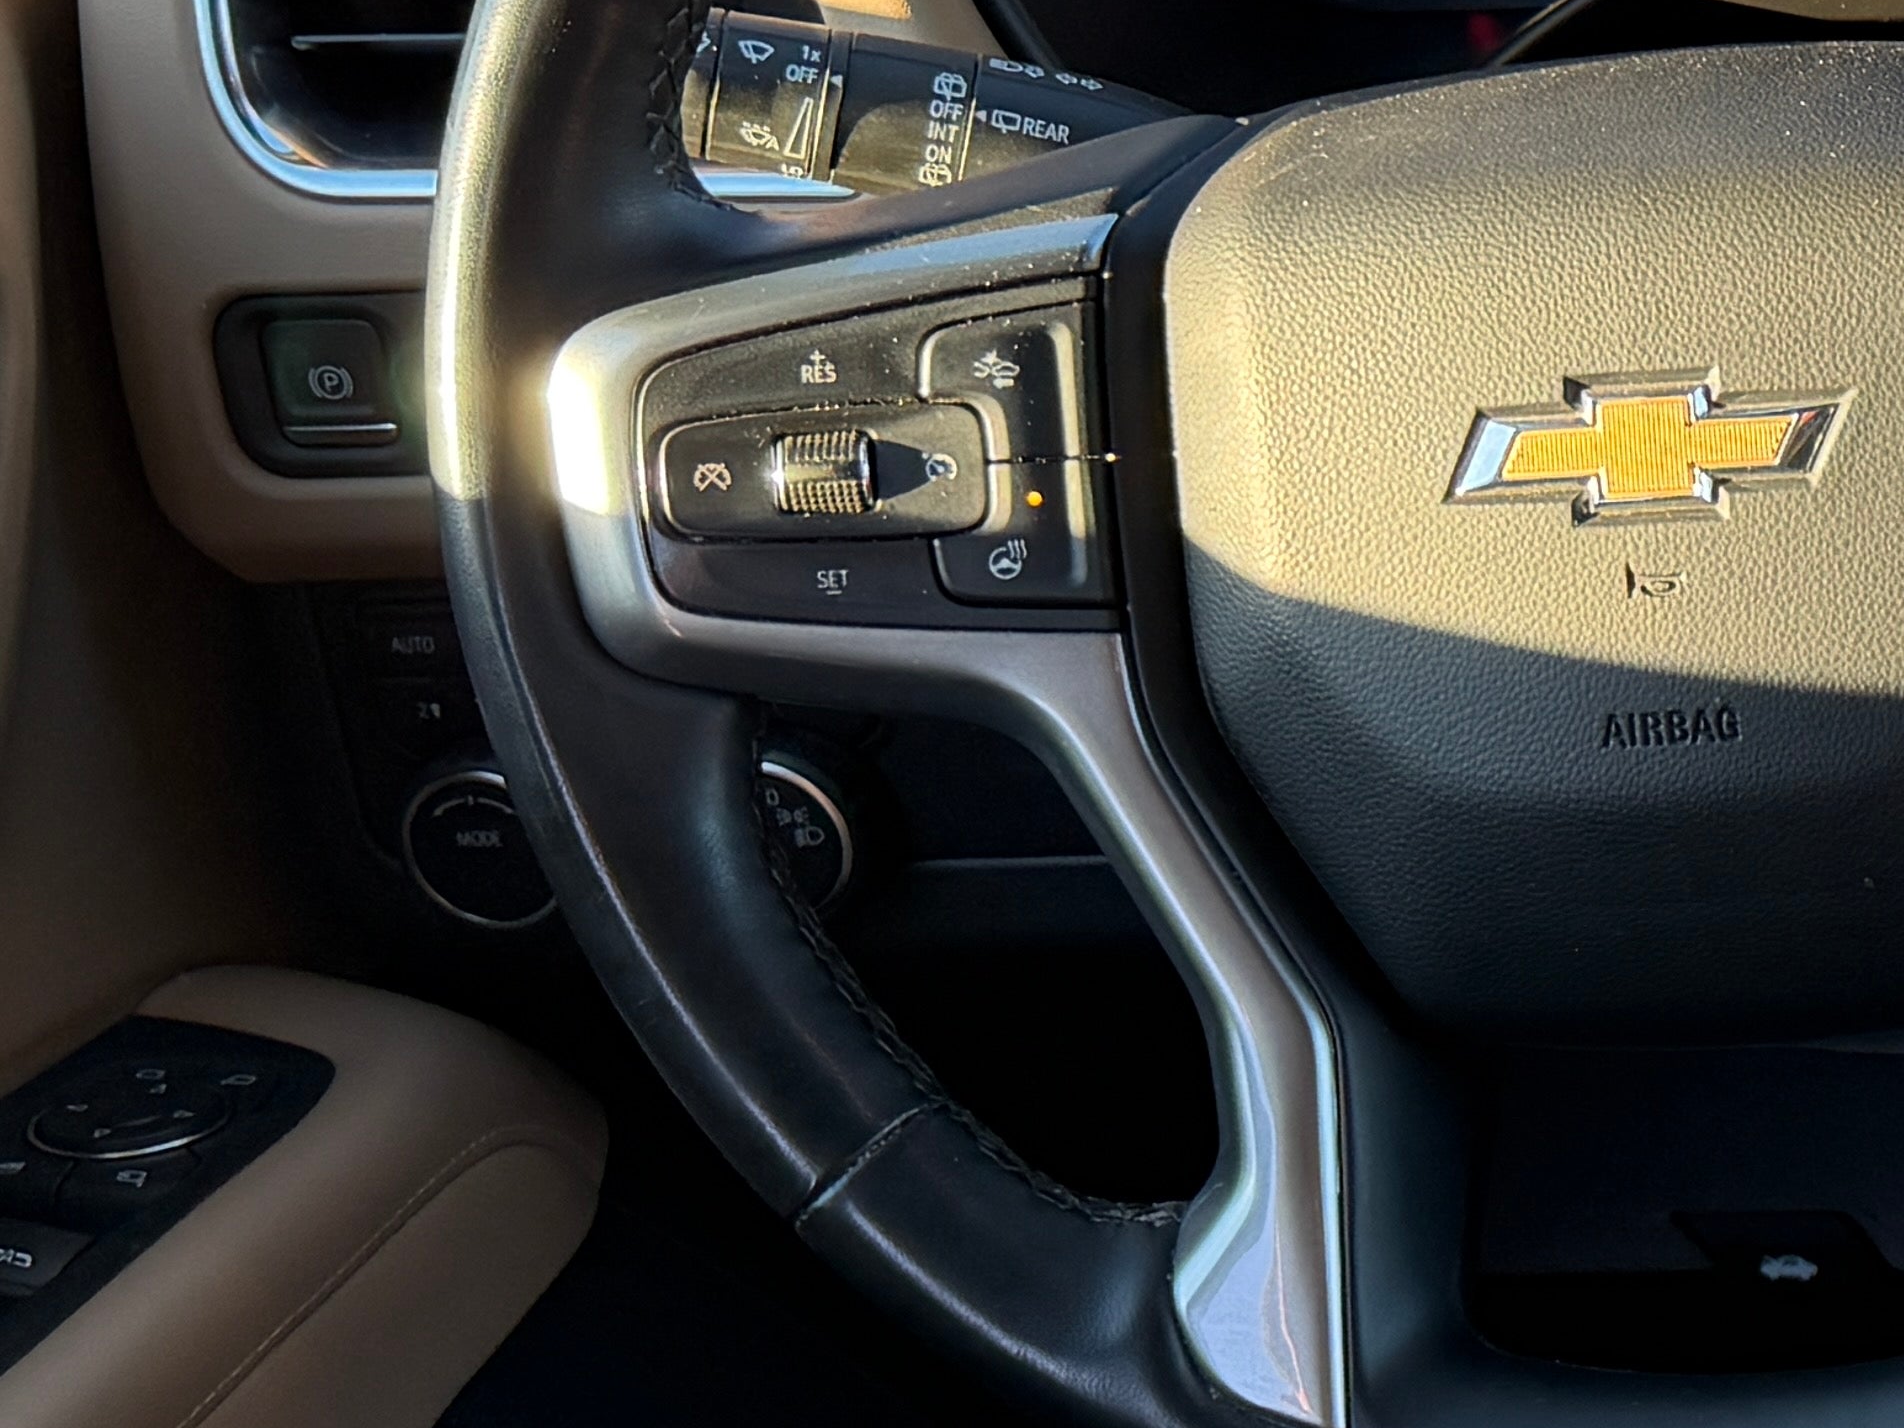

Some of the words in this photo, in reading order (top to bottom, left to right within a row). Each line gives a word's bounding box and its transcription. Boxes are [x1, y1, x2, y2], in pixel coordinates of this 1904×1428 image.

[785, 64, 819, 85] OFF
[930, 99, 964, 121] OFF
[927, 123, 960, 144] INT
[1022, 120, 1070, 144] REAR
[925, 144, 952, 164] ON
[800, 363, 837, 385] RES
[816, 570, 849, 589] SET
[391, 635, 436, 655] AUTO
[1601, 703, 1742, 750] AIRBAG
